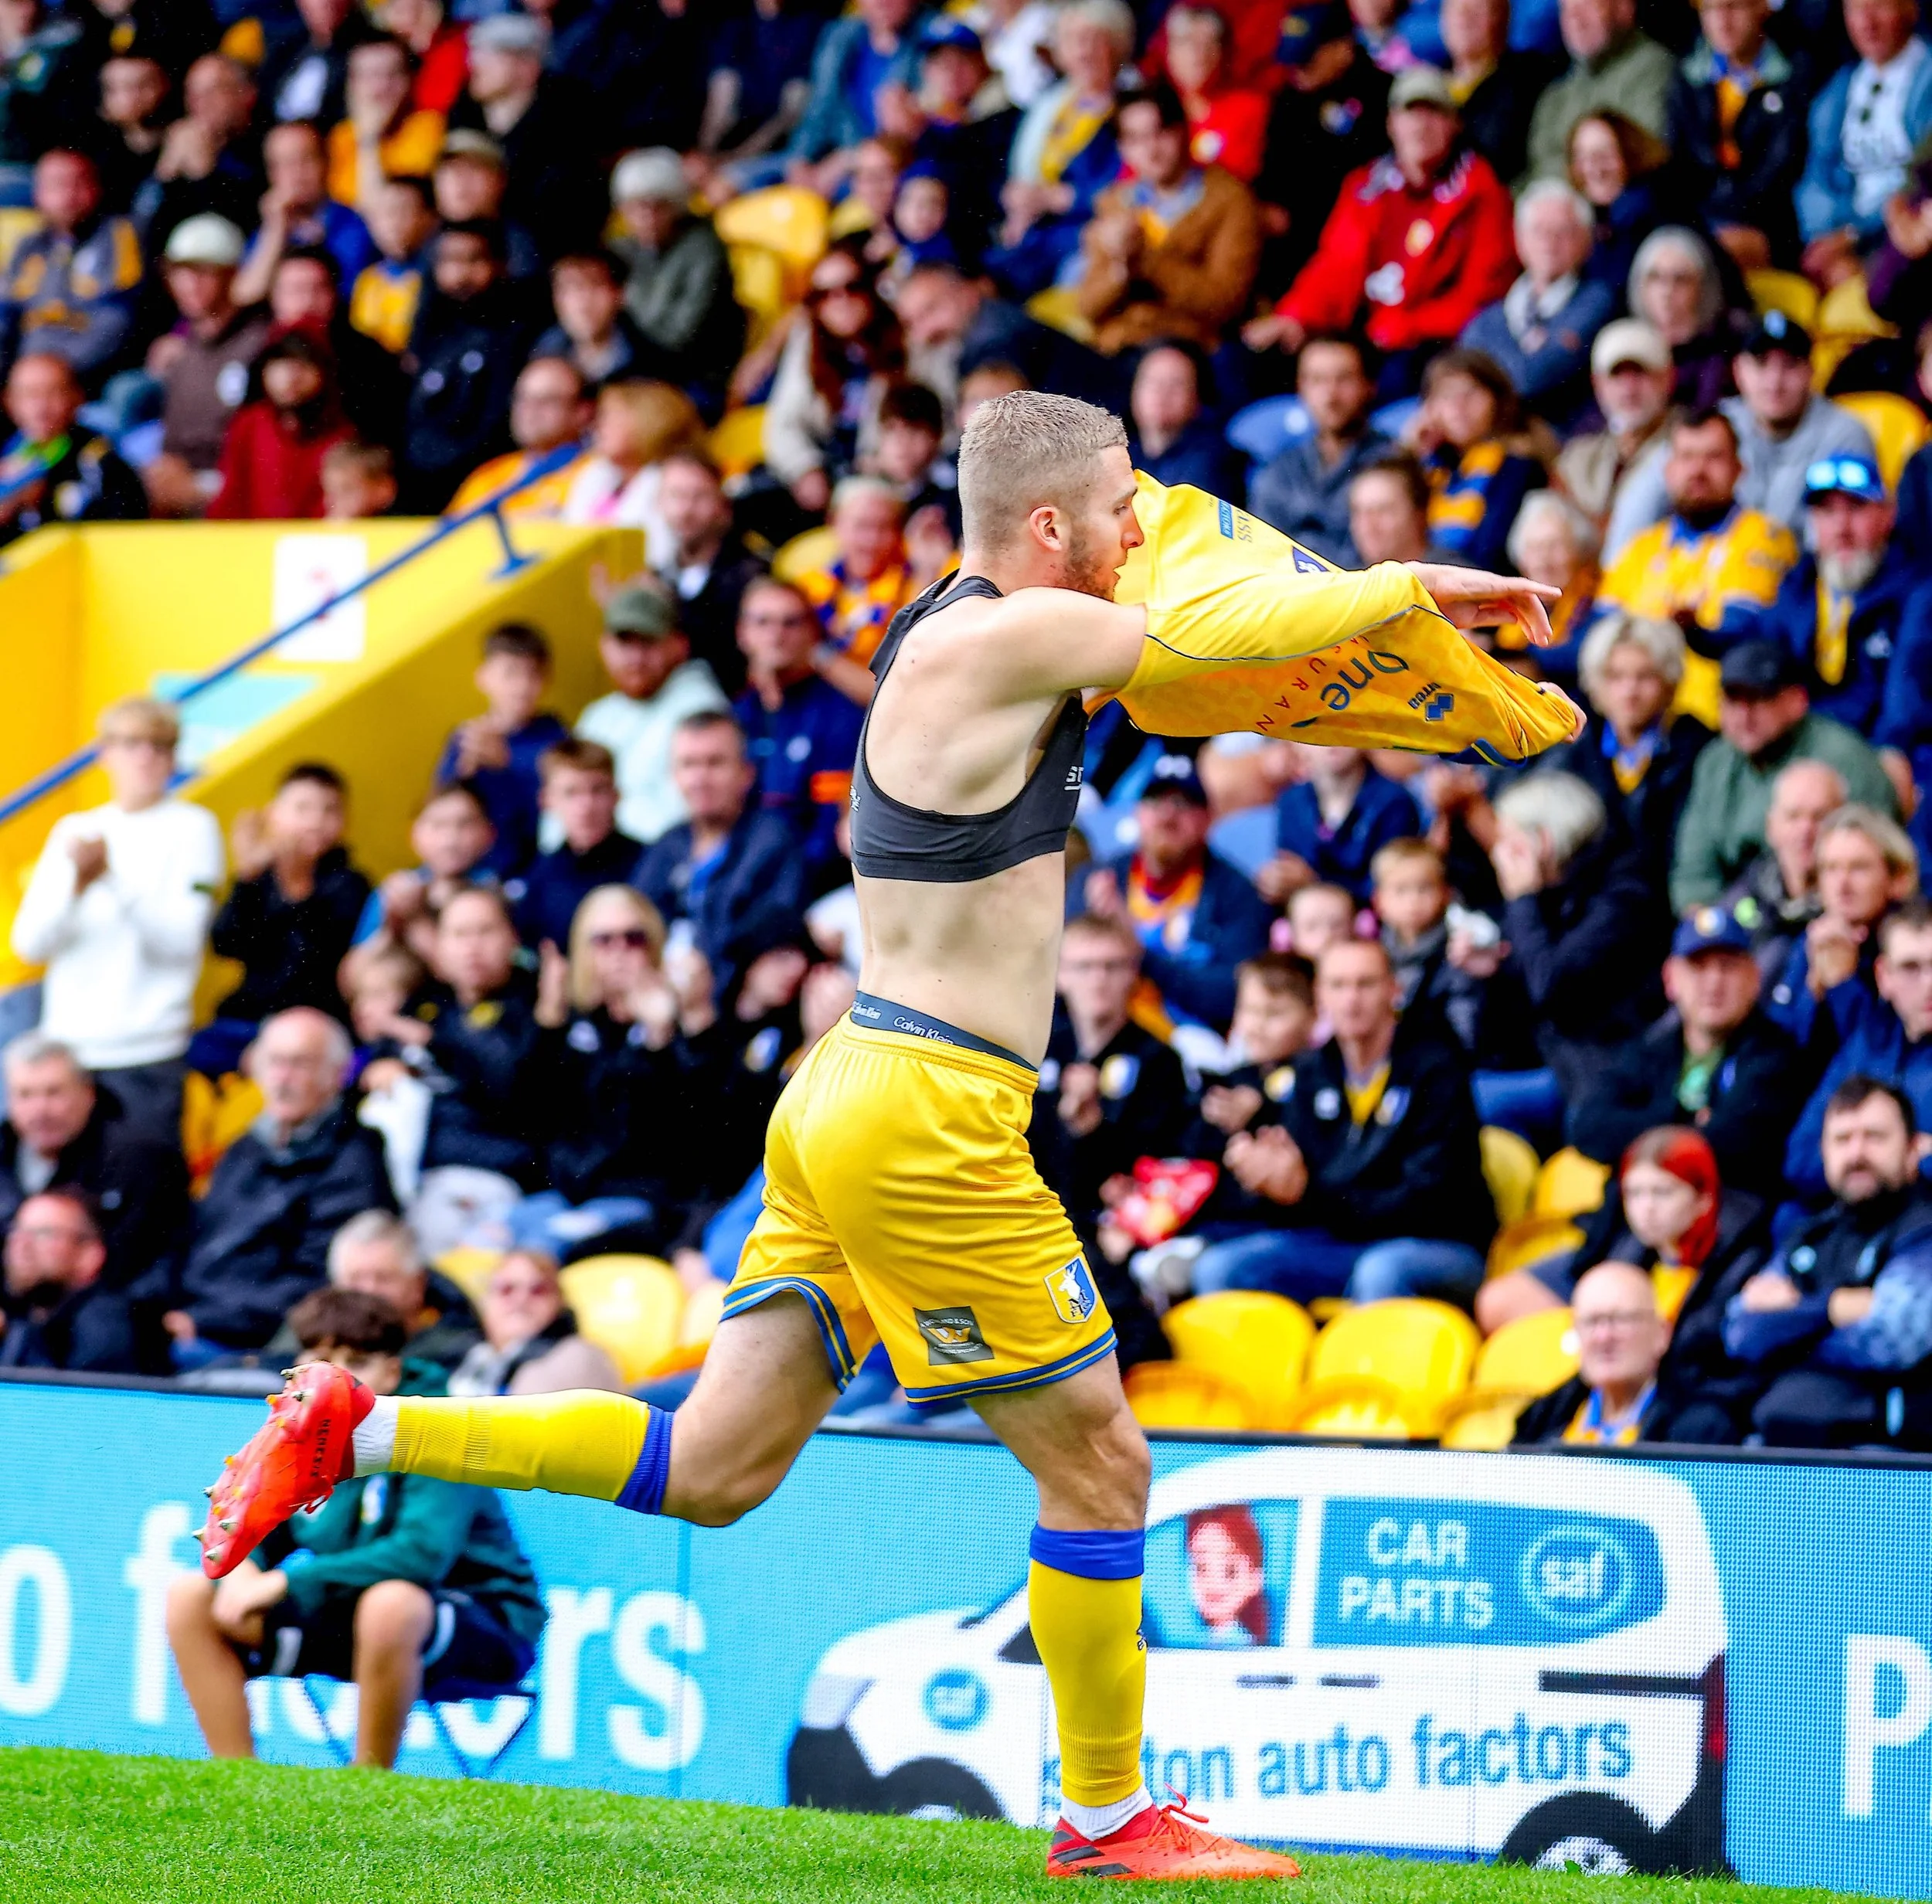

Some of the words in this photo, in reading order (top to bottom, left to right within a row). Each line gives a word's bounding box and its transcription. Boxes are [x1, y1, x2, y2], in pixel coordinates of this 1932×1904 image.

[1320, 649, 1410, 711] One
[893, 1016, 926, 1036] Calvin
[1366, 1517, 1468, 1567] CAR
[1338, 1575, 1495, 1629] PARTS
[1257, 1722, 1389, 1798] auto
[1412, 1710, 1631, 1788] factors
